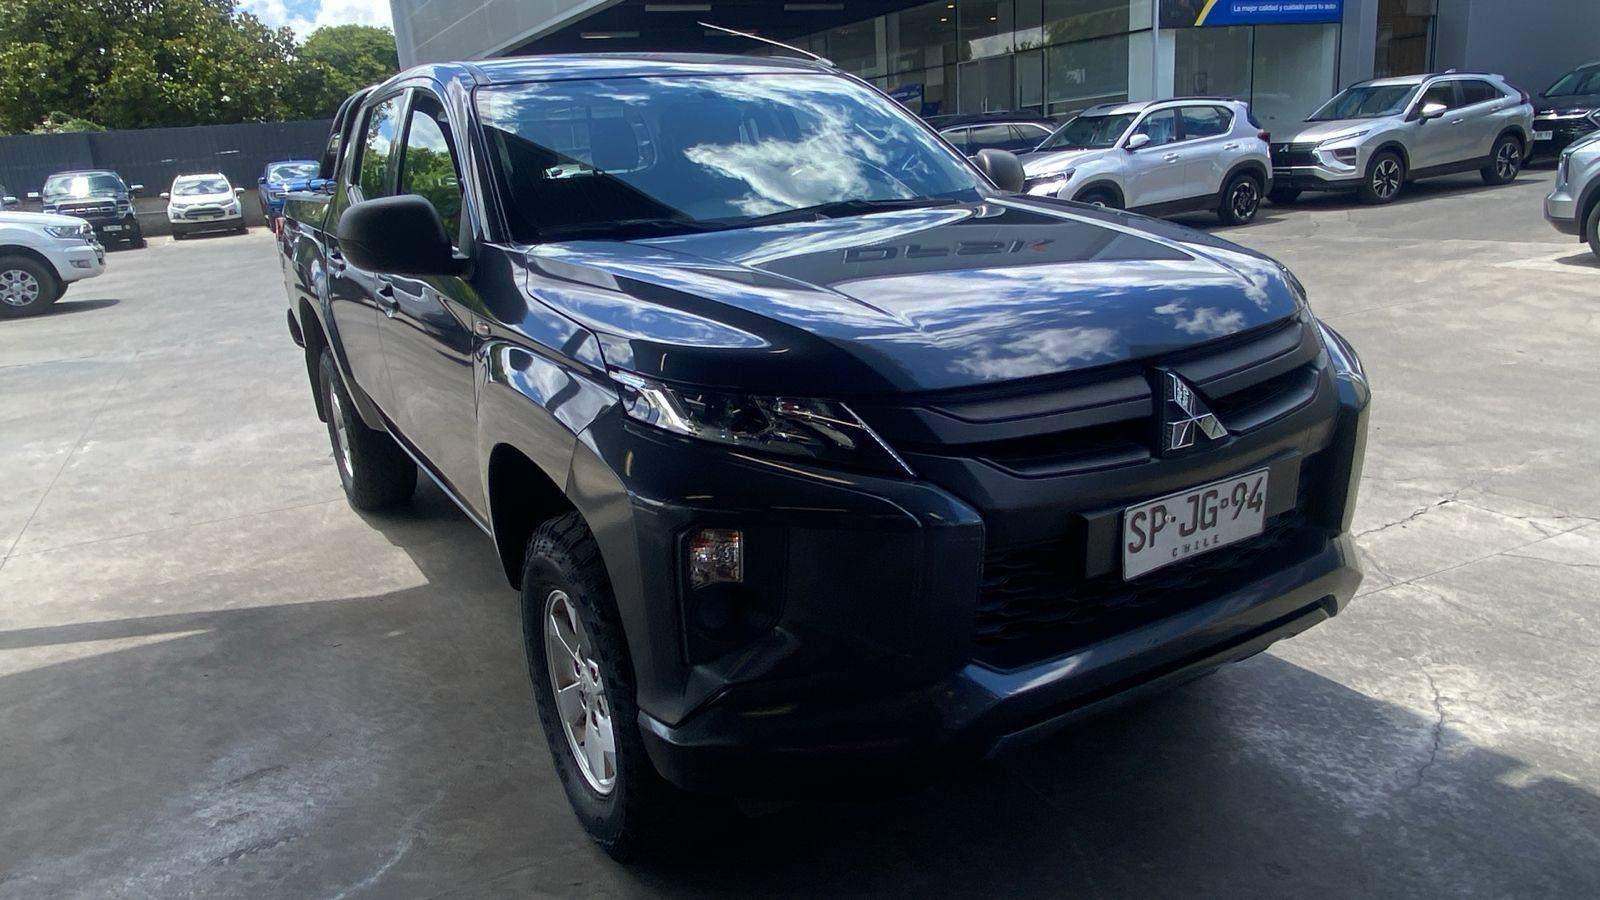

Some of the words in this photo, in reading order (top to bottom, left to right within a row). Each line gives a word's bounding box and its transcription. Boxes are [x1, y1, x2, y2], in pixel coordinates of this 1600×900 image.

[1242, 5, 1257, 13] mejor
[1259, 4, 1278, 12] calidad
[1305, 4, 1317, 12] para
[1172, 535, 1220, 557] CHILE
